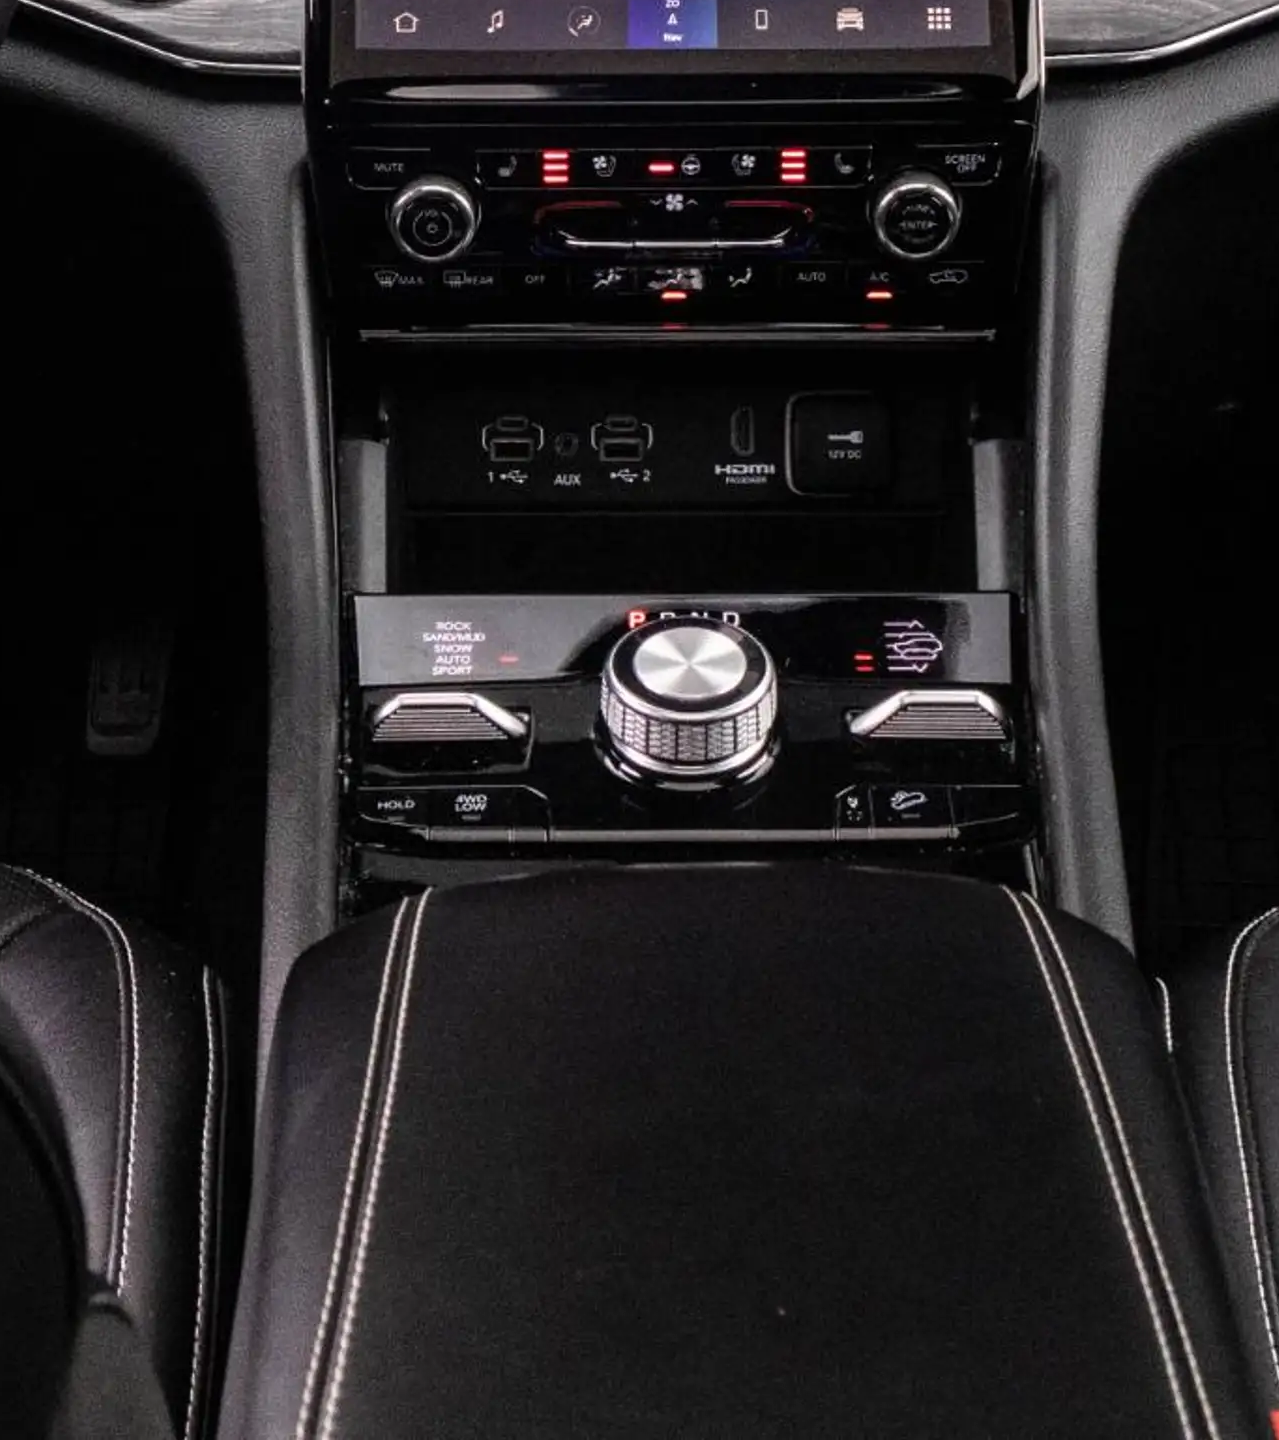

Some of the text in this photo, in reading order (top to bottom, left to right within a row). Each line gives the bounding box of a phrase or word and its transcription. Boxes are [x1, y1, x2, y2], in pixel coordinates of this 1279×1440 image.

[373, 162, 405, 173] MUTE
[524, 274, 546, 285] OFF
[796, 271, 827, 282] AUTO
[870, 271, 890, 282] A/C
[642, 468, 652, 482] 2
[714, 464, 776, 475] HDMI
[553, 473, 582, 486] AUX
[628, 610, 647, 630] P
[435, 621, 473, 631] ROCK
[433, 643, 474, 653] SNOW
[435, 654, 471, 665] AUTO
[431, 665, 473, 676] SPORT
[377, 799, 416, 811] HOLD
[454, 803, 488, 812] LOW
